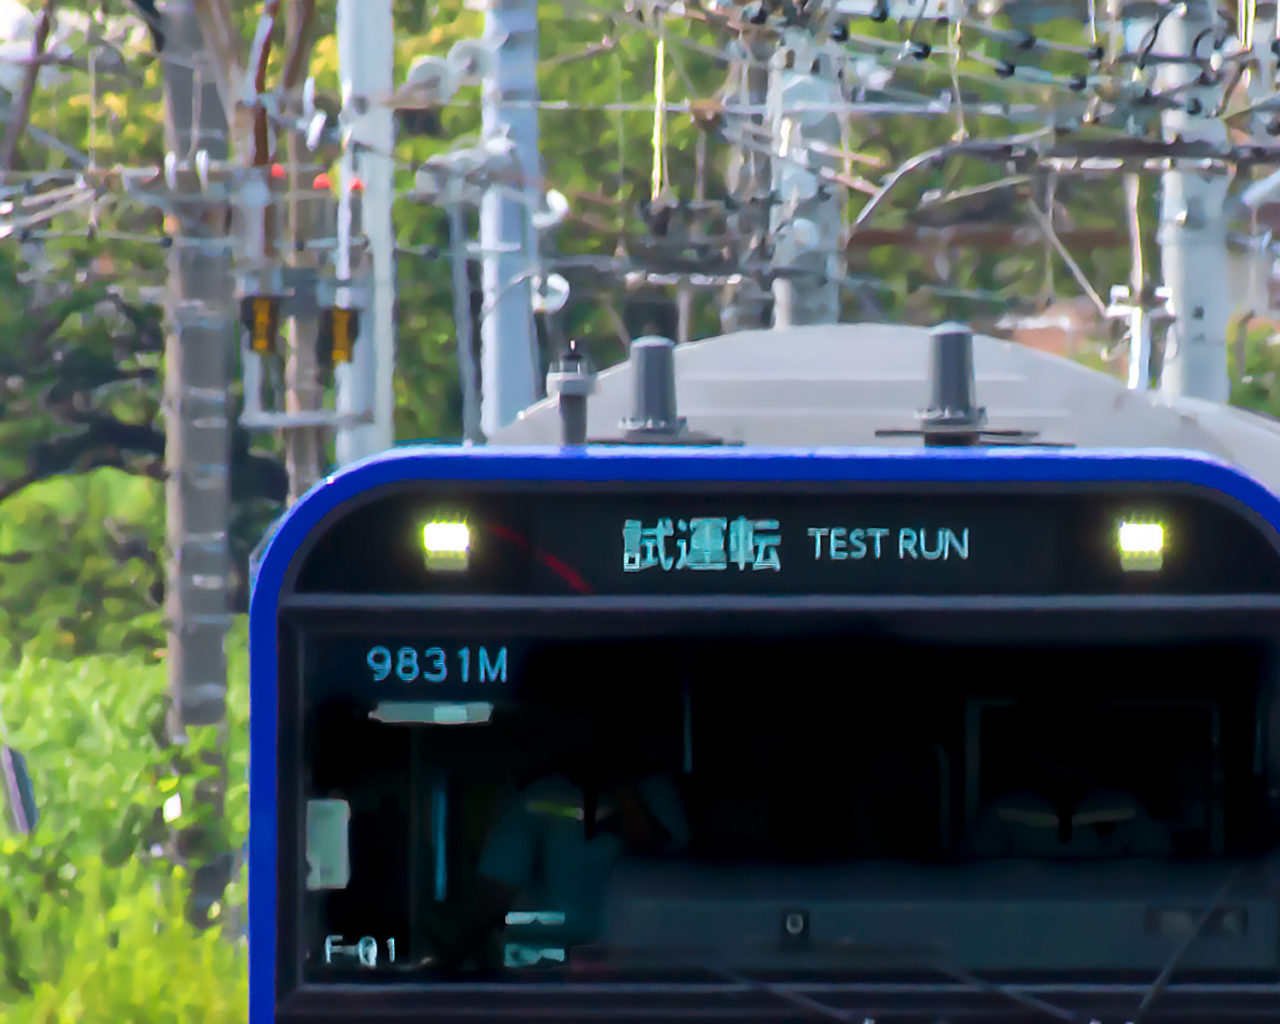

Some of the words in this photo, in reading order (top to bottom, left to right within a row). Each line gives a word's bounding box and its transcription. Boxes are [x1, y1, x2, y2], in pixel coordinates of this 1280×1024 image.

[623, 515, 780, 572] 試運転
[808, 527, 889, 560] TEST
[899, 527, 969, 560] RUN
[366, 645, 508, 683] 9831M
[325, 935, 396, 968] F-01
